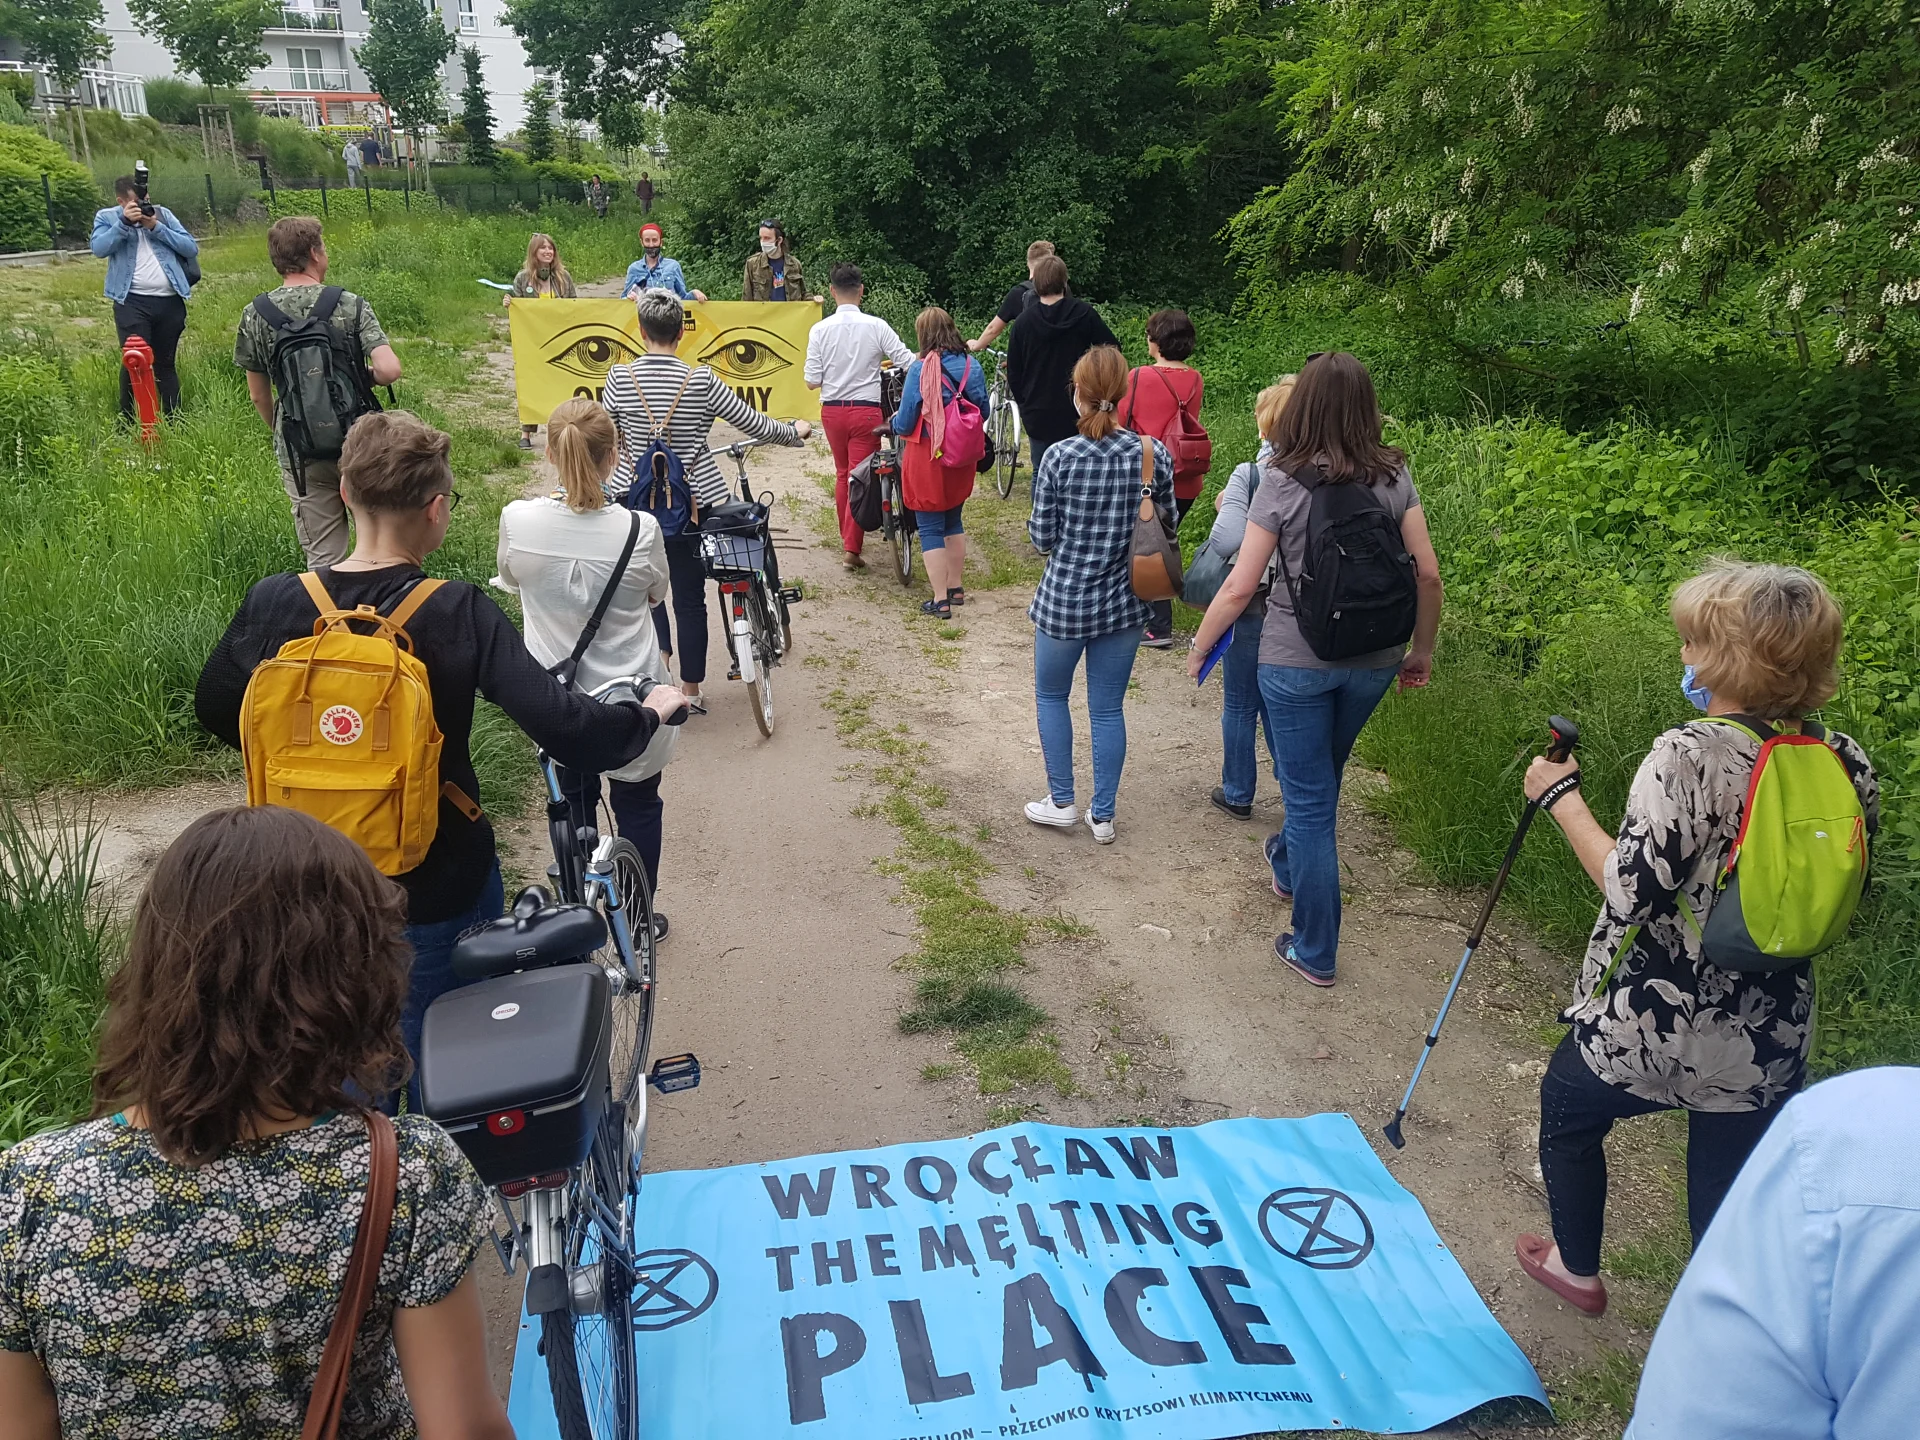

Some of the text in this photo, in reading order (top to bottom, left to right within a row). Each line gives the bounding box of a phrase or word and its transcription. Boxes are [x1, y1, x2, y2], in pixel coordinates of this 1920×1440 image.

[760, 1135, 1179, 1220] WROCŁAW
[765, 1200, 1224, 1292] THE MELTING
[780, 1265, 1297, 1426] PLACE
[999, 1406, 1090, 1437] PRZECIWKO
[1094, 1396, 1186, 1422] KRYZYSOWI
[1189, 1391, 1314, 1406] KLIMATYCZNEMU
